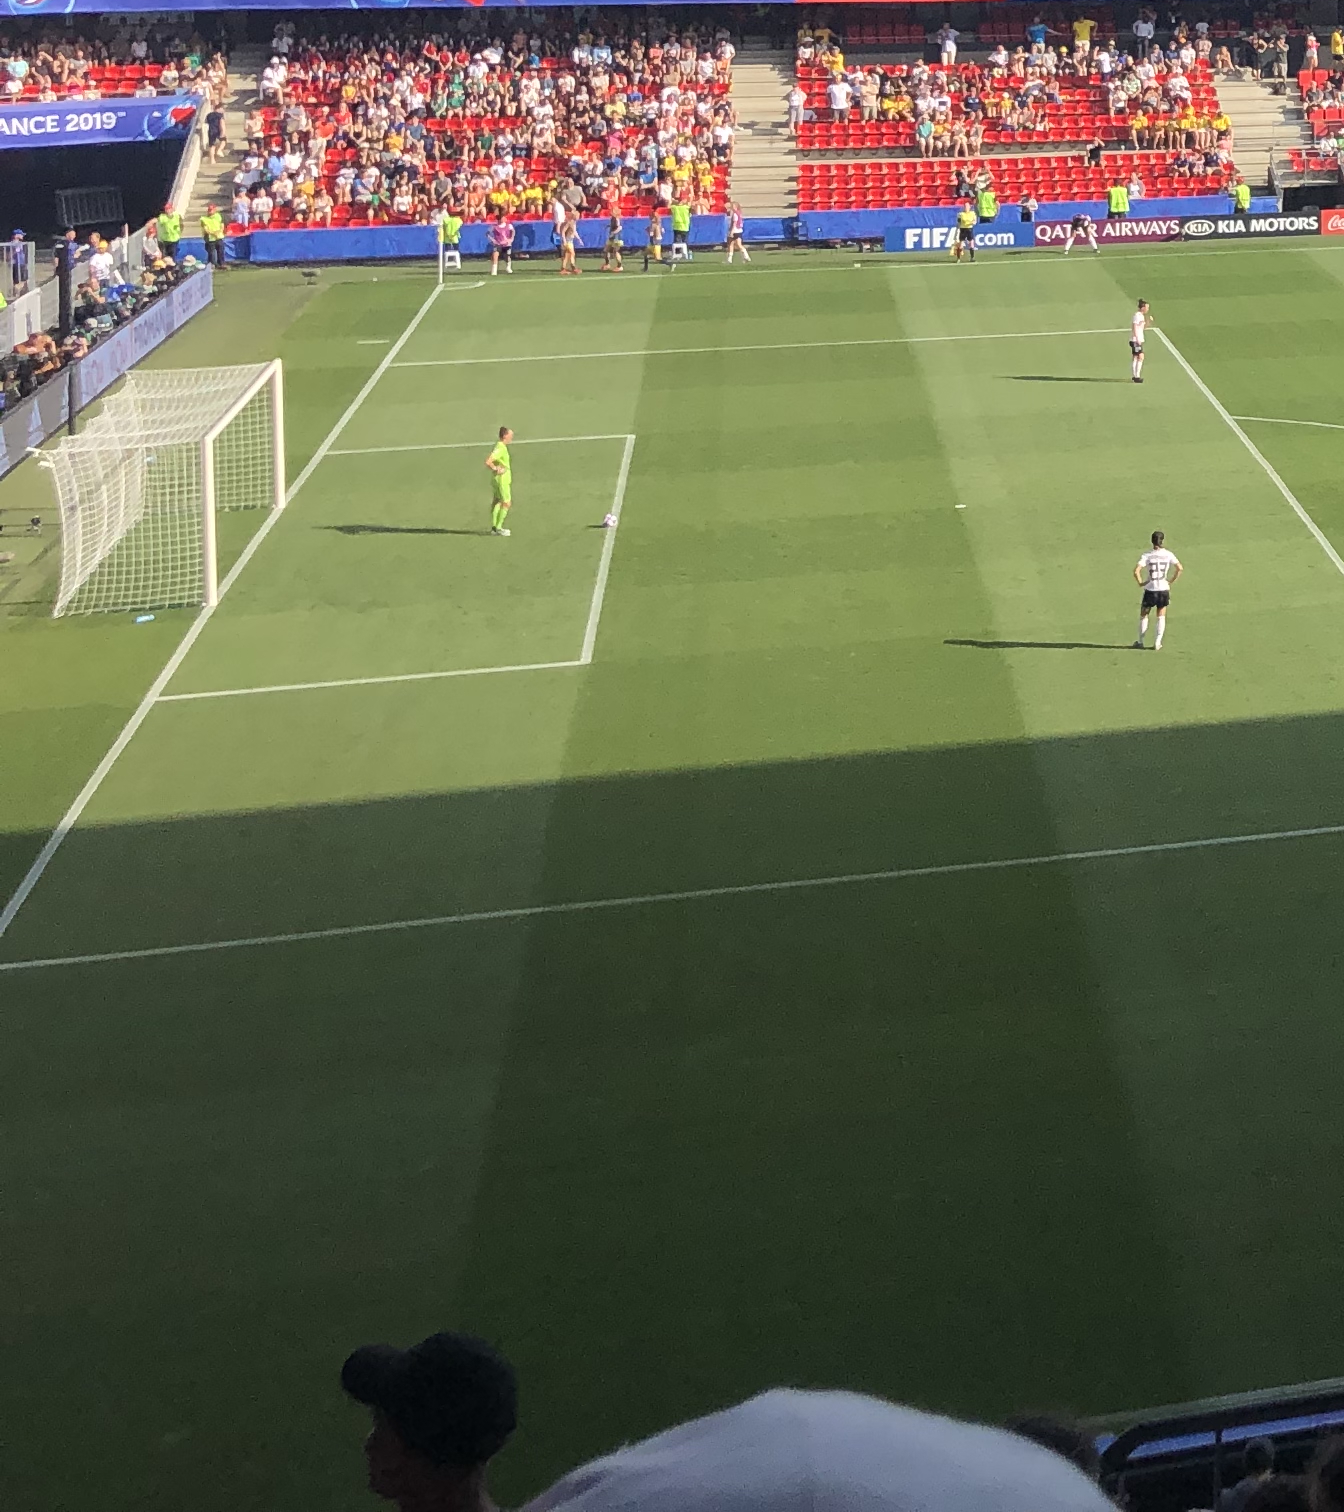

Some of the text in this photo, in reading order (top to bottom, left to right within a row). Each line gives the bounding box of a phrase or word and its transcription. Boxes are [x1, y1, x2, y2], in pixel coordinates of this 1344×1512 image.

[1102, 219, 1180, 237] AIRWAYS
[1190, 223, 1210, 233] KIA
[1217, 216, 1319, 233] KIA MOTORS
